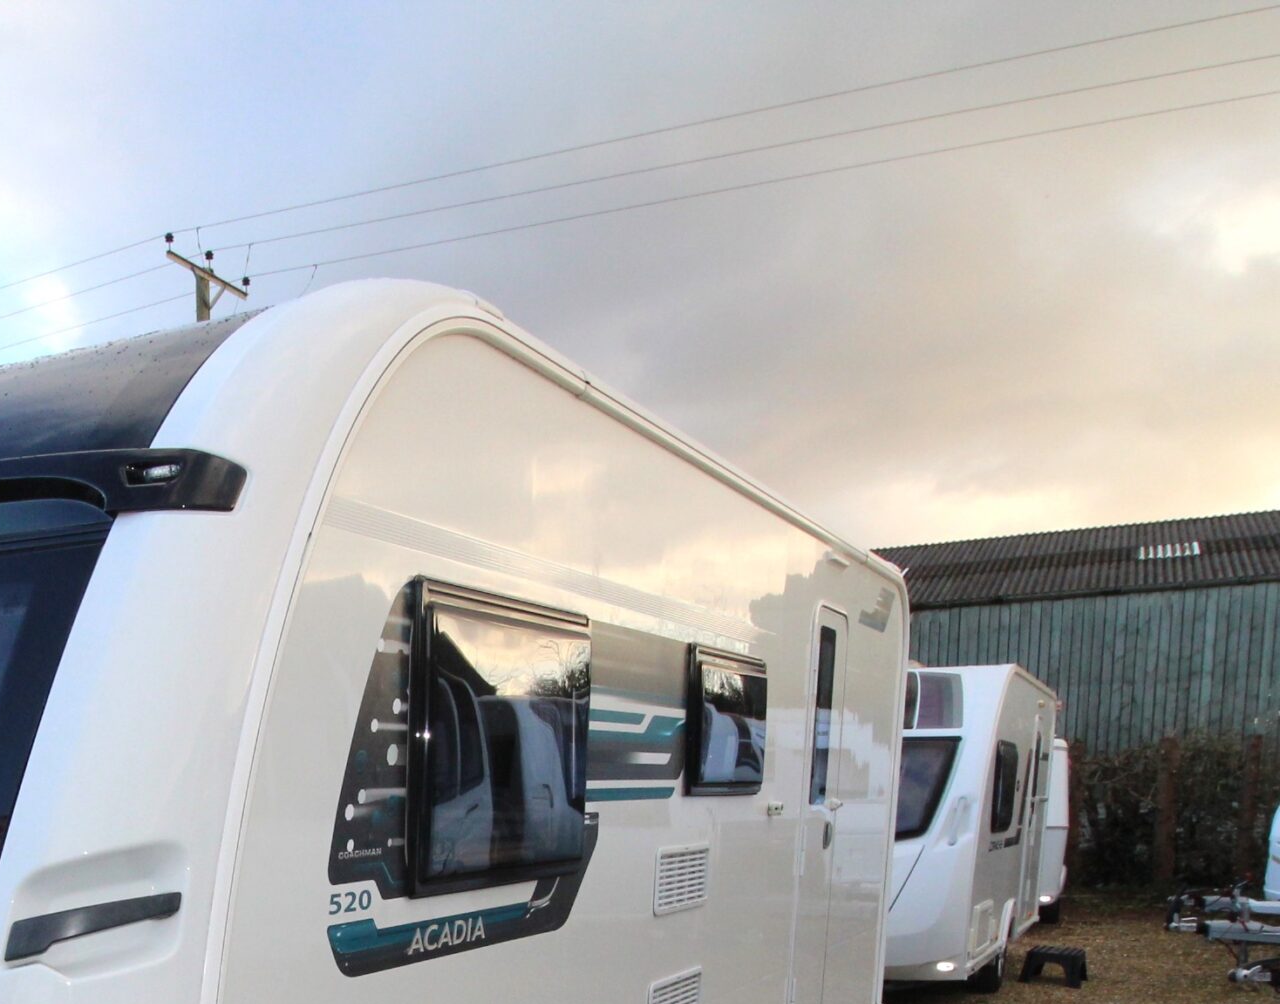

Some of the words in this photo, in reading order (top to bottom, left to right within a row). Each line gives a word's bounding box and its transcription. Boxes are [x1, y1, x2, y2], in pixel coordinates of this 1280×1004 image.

[338, 847, 382, 860] COACHMAN
[328, 889, 371, 915] 520
[407, 915, 485, 956] ACADIA
